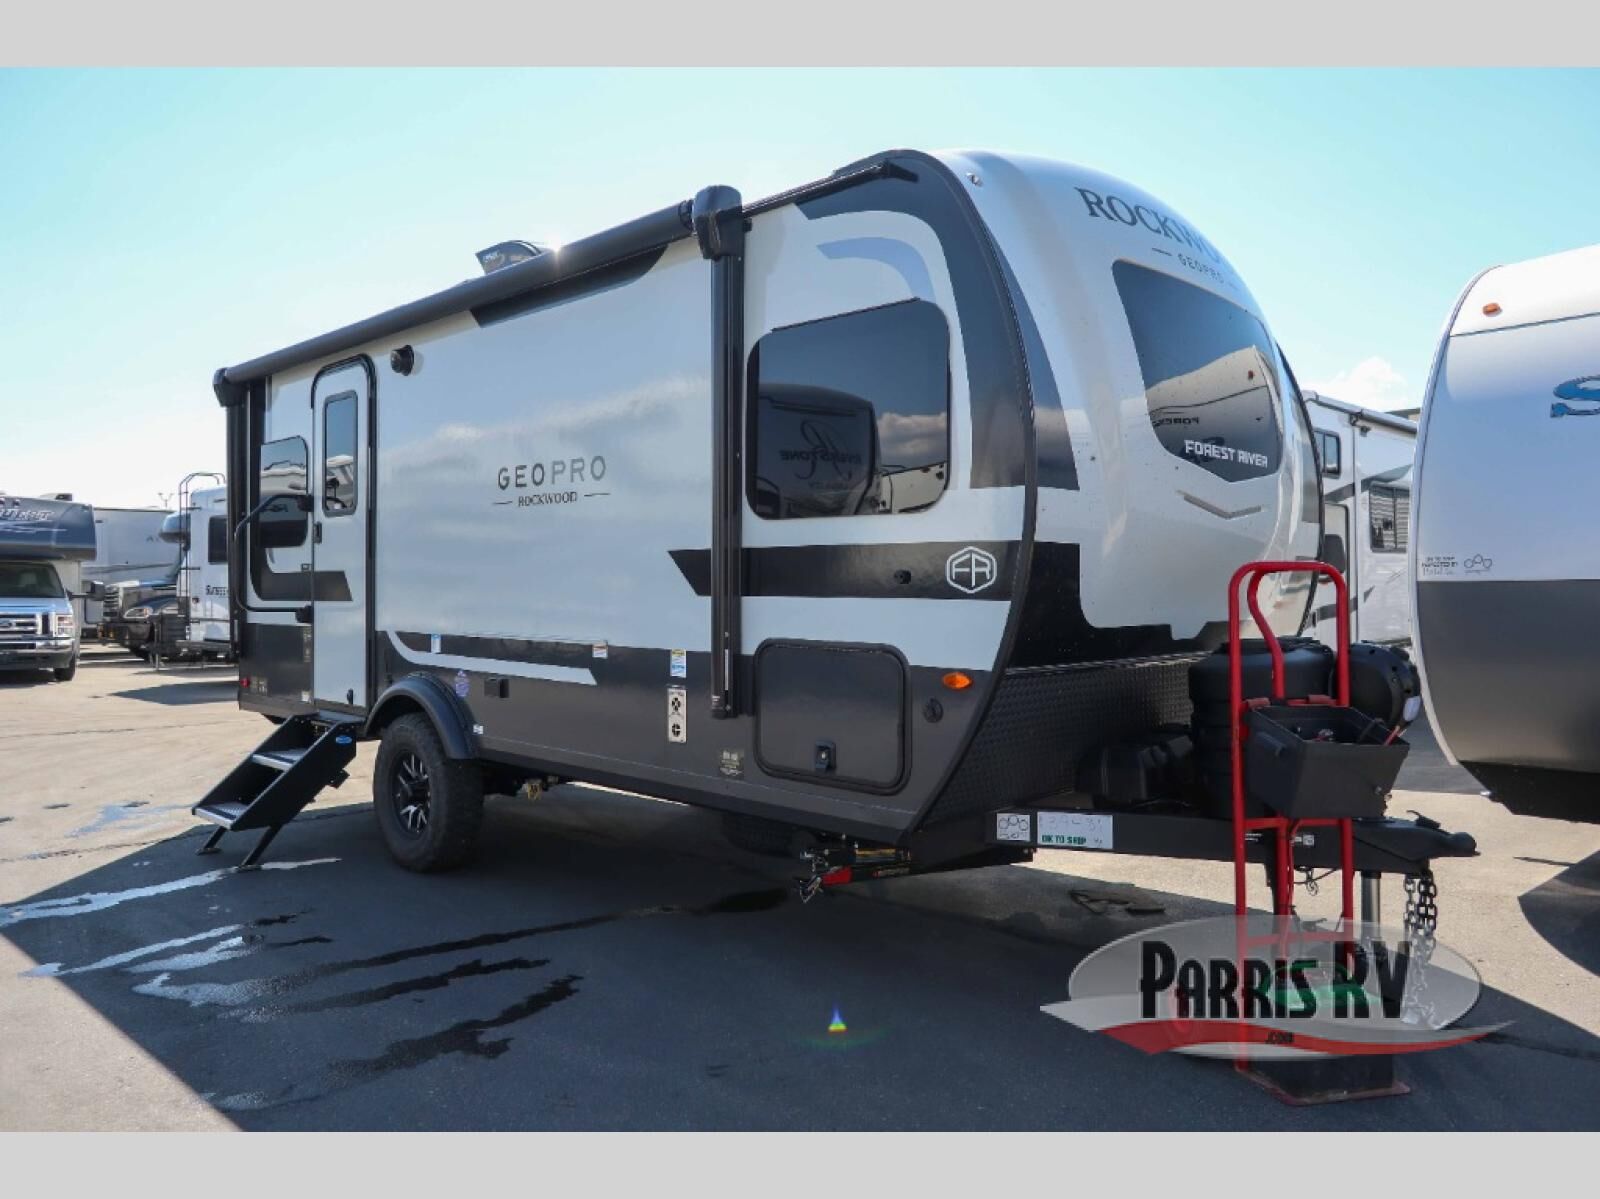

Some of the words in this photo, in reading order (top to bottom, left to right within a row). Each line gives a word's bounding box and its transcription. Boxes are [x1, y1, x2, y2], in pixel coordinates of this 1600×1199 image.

[1184, 439, 1235, 461] FOREST
[1237, 450, 1268, 469] RIVER
[497, 455, 607, 491] GEOPRO
[518, 491, 578, 507] ROCKWOOD
[1055, 835, 1065, 844] TO
